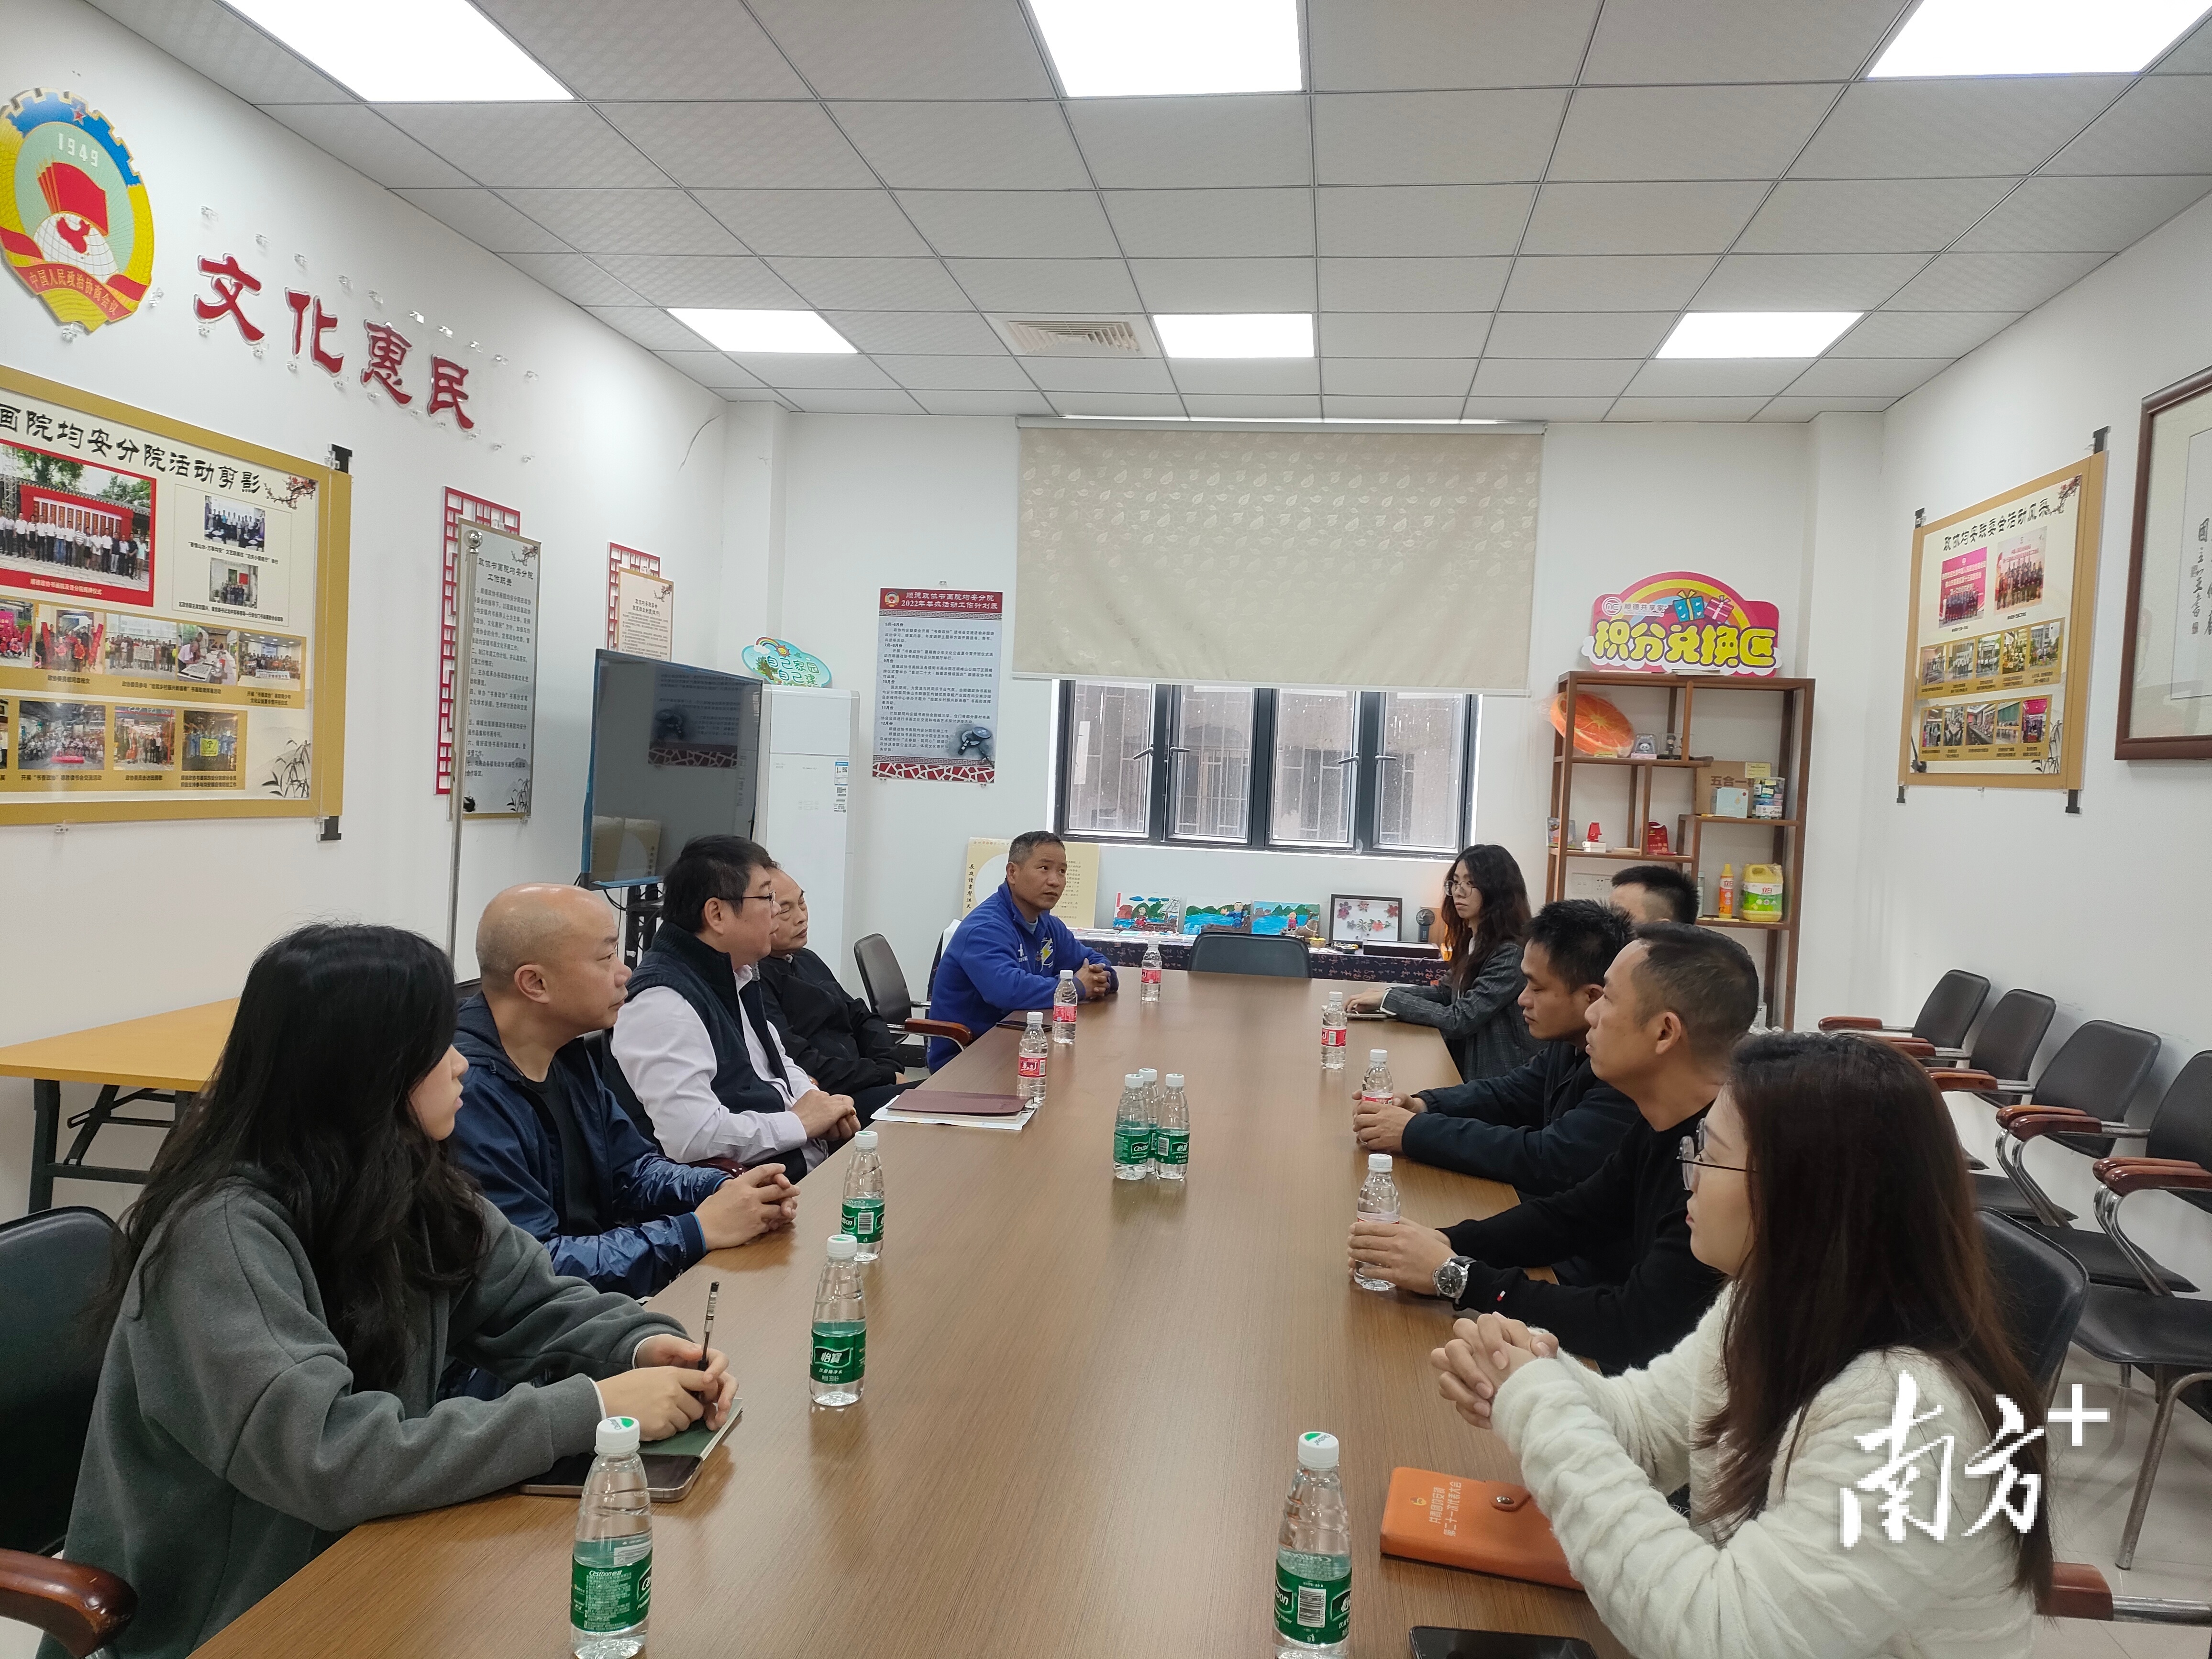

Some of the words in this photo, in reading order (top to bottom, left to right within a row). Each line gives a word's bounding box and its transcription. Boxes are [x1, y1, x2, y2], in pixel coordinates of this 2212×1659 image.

[57, 133, 100, 169] 1949
[29, 268, 119, 316] 中国人民政治协商会议
[194, 255, 476, 431] 文化惠民
[0, 403, 261, 495] 画院均安分院活动剪影
[1943, 498, 2050, 552] 政协均安联委会活动风采
[487, 573, 512, 586] 工作职责
[906, 591, 995, 602] 顺德政协书画院均安分院
[901, 599, 998, 610] 2022年举办活动工作计划表
[767, 655, 820, 674] 自己家园
[1593, 619, 1777, 668] 积分兑换区
[778, 669, 818, 686] 自己建
[1443, 1481, 1462, 1537] 第二十一次代表大会
